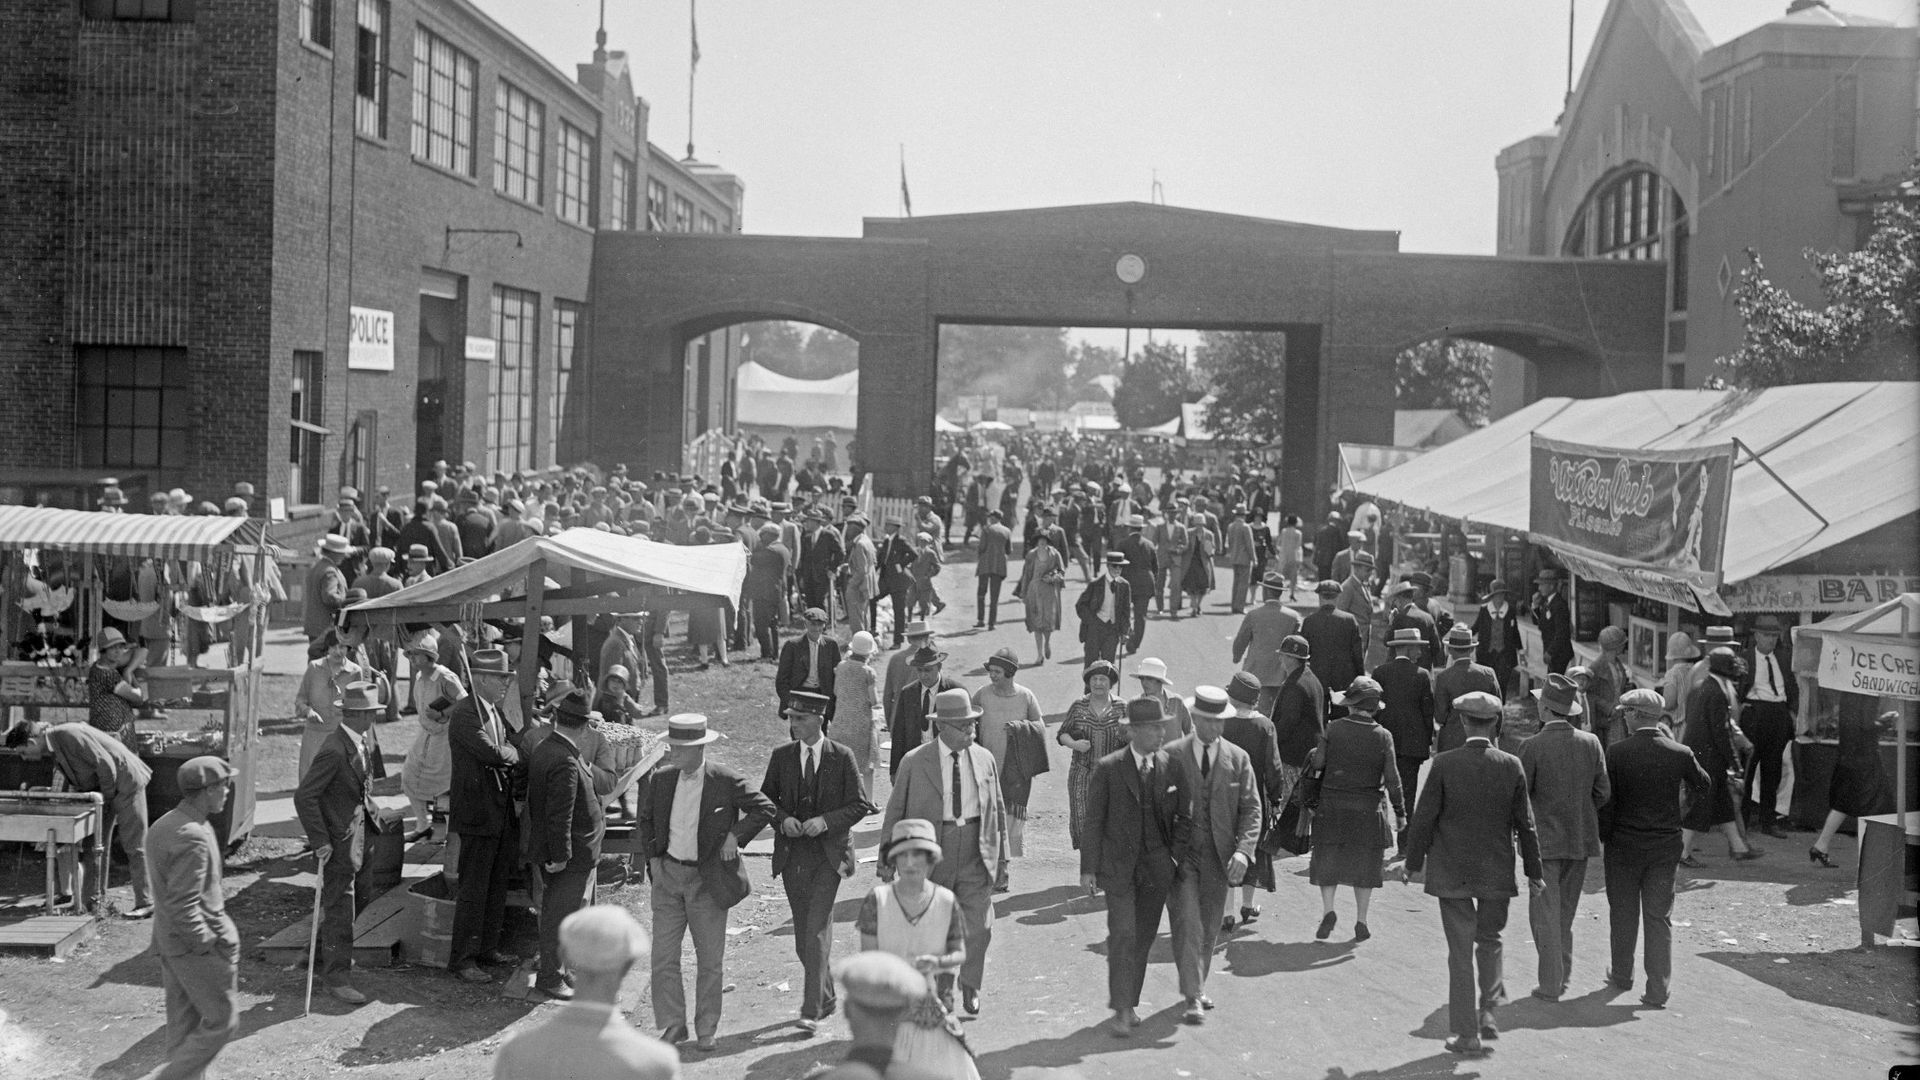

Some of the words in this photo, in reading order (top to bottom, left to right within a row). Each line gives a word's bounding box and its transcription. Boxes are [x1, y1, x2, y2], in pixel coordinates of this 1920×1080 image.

[350, 313, 389, 345] POLICE
[1550, 456, 1611, 511] Utica
[1610, 457, 1655, 521] Club
[1850, 646, 1878, 670] ICE
[1881, 653, 1920, 676] CRE
[1851, 670, 1920, 695] SANDWICH
